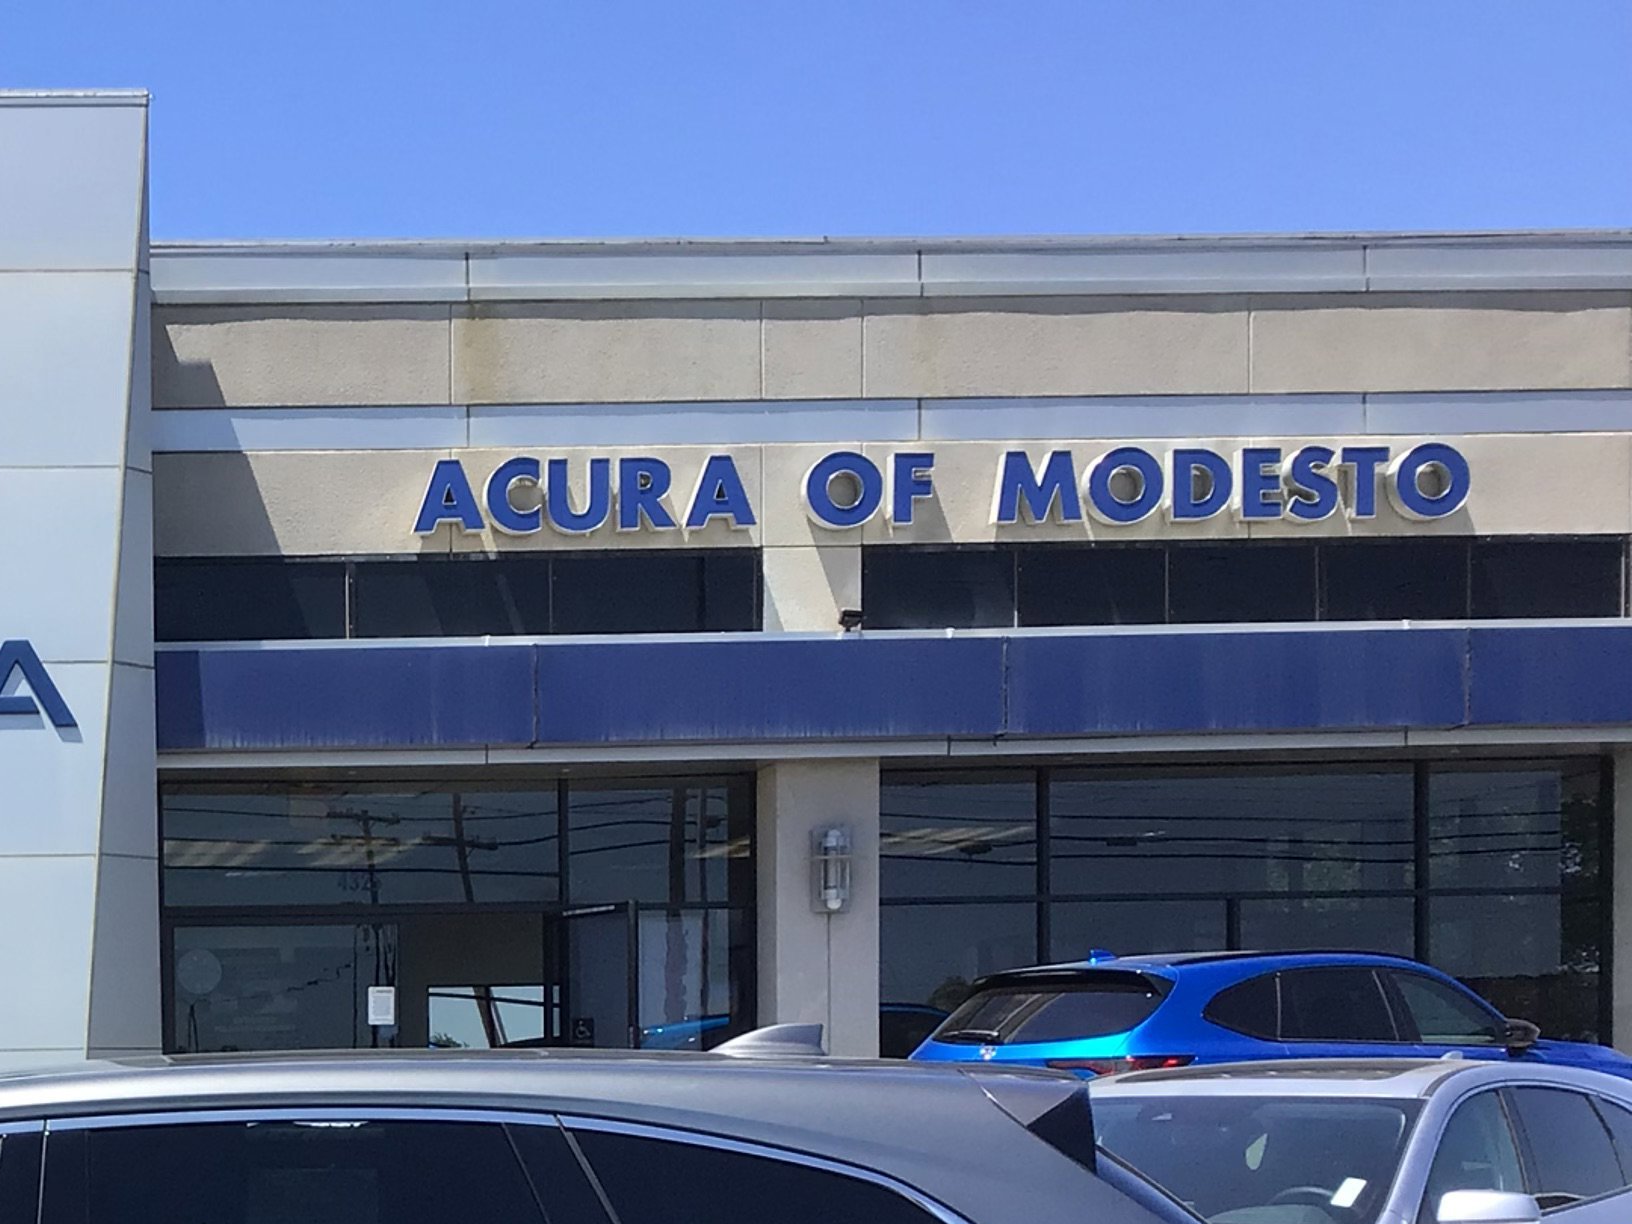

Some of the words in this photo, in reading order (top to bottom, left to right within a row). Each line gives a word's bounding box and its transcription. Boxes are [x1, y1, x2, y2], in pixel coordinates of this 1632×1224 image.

[413, 453, 758, 535] ACURA
[800, 450, 935, 530] OF
[990, 442, 1472, 526] MODESTO
